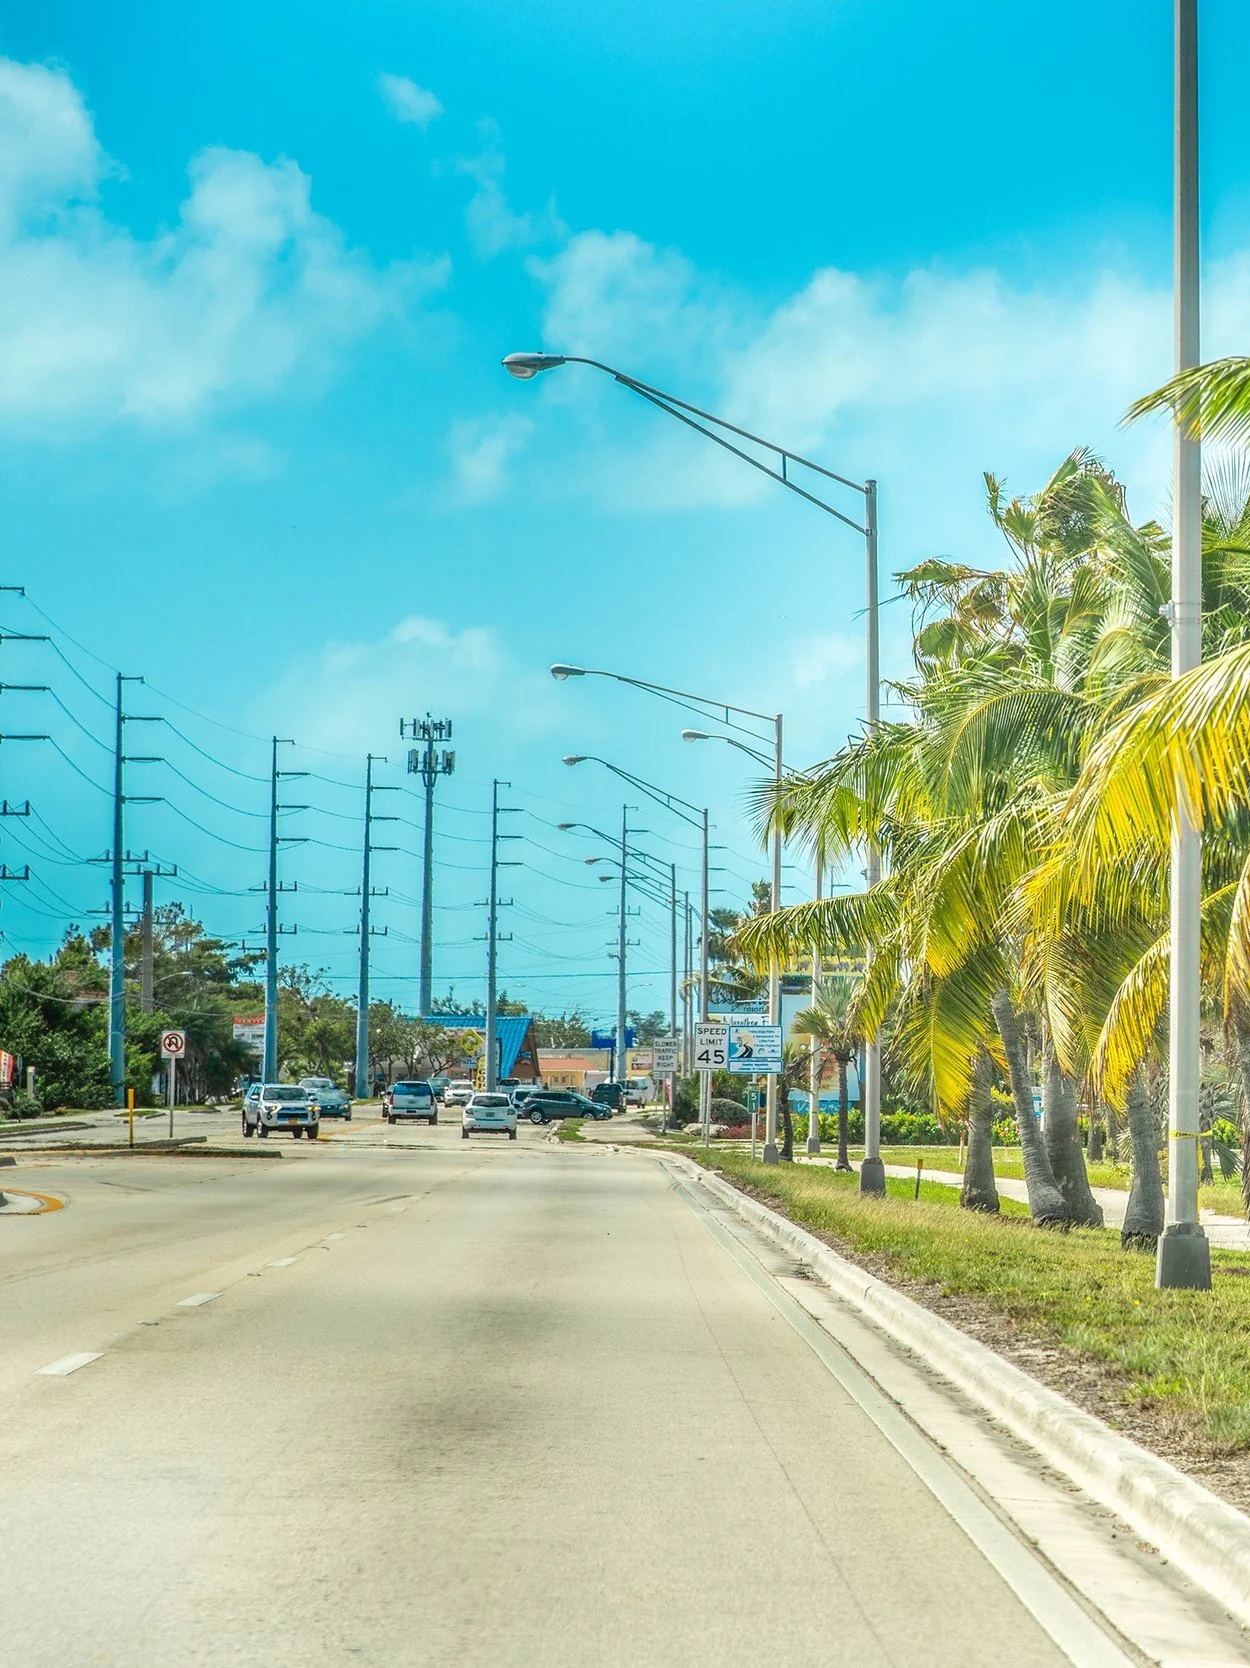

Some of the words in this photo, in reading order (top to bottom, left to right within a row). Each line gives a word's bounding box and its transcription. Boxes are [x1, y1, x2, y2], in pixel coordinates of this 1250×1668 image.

[697, 1027, 727, 1036] SPEED
[700, 1038, 724, 1046] LIMIT
[697, 1049, 725, 1065] 45
